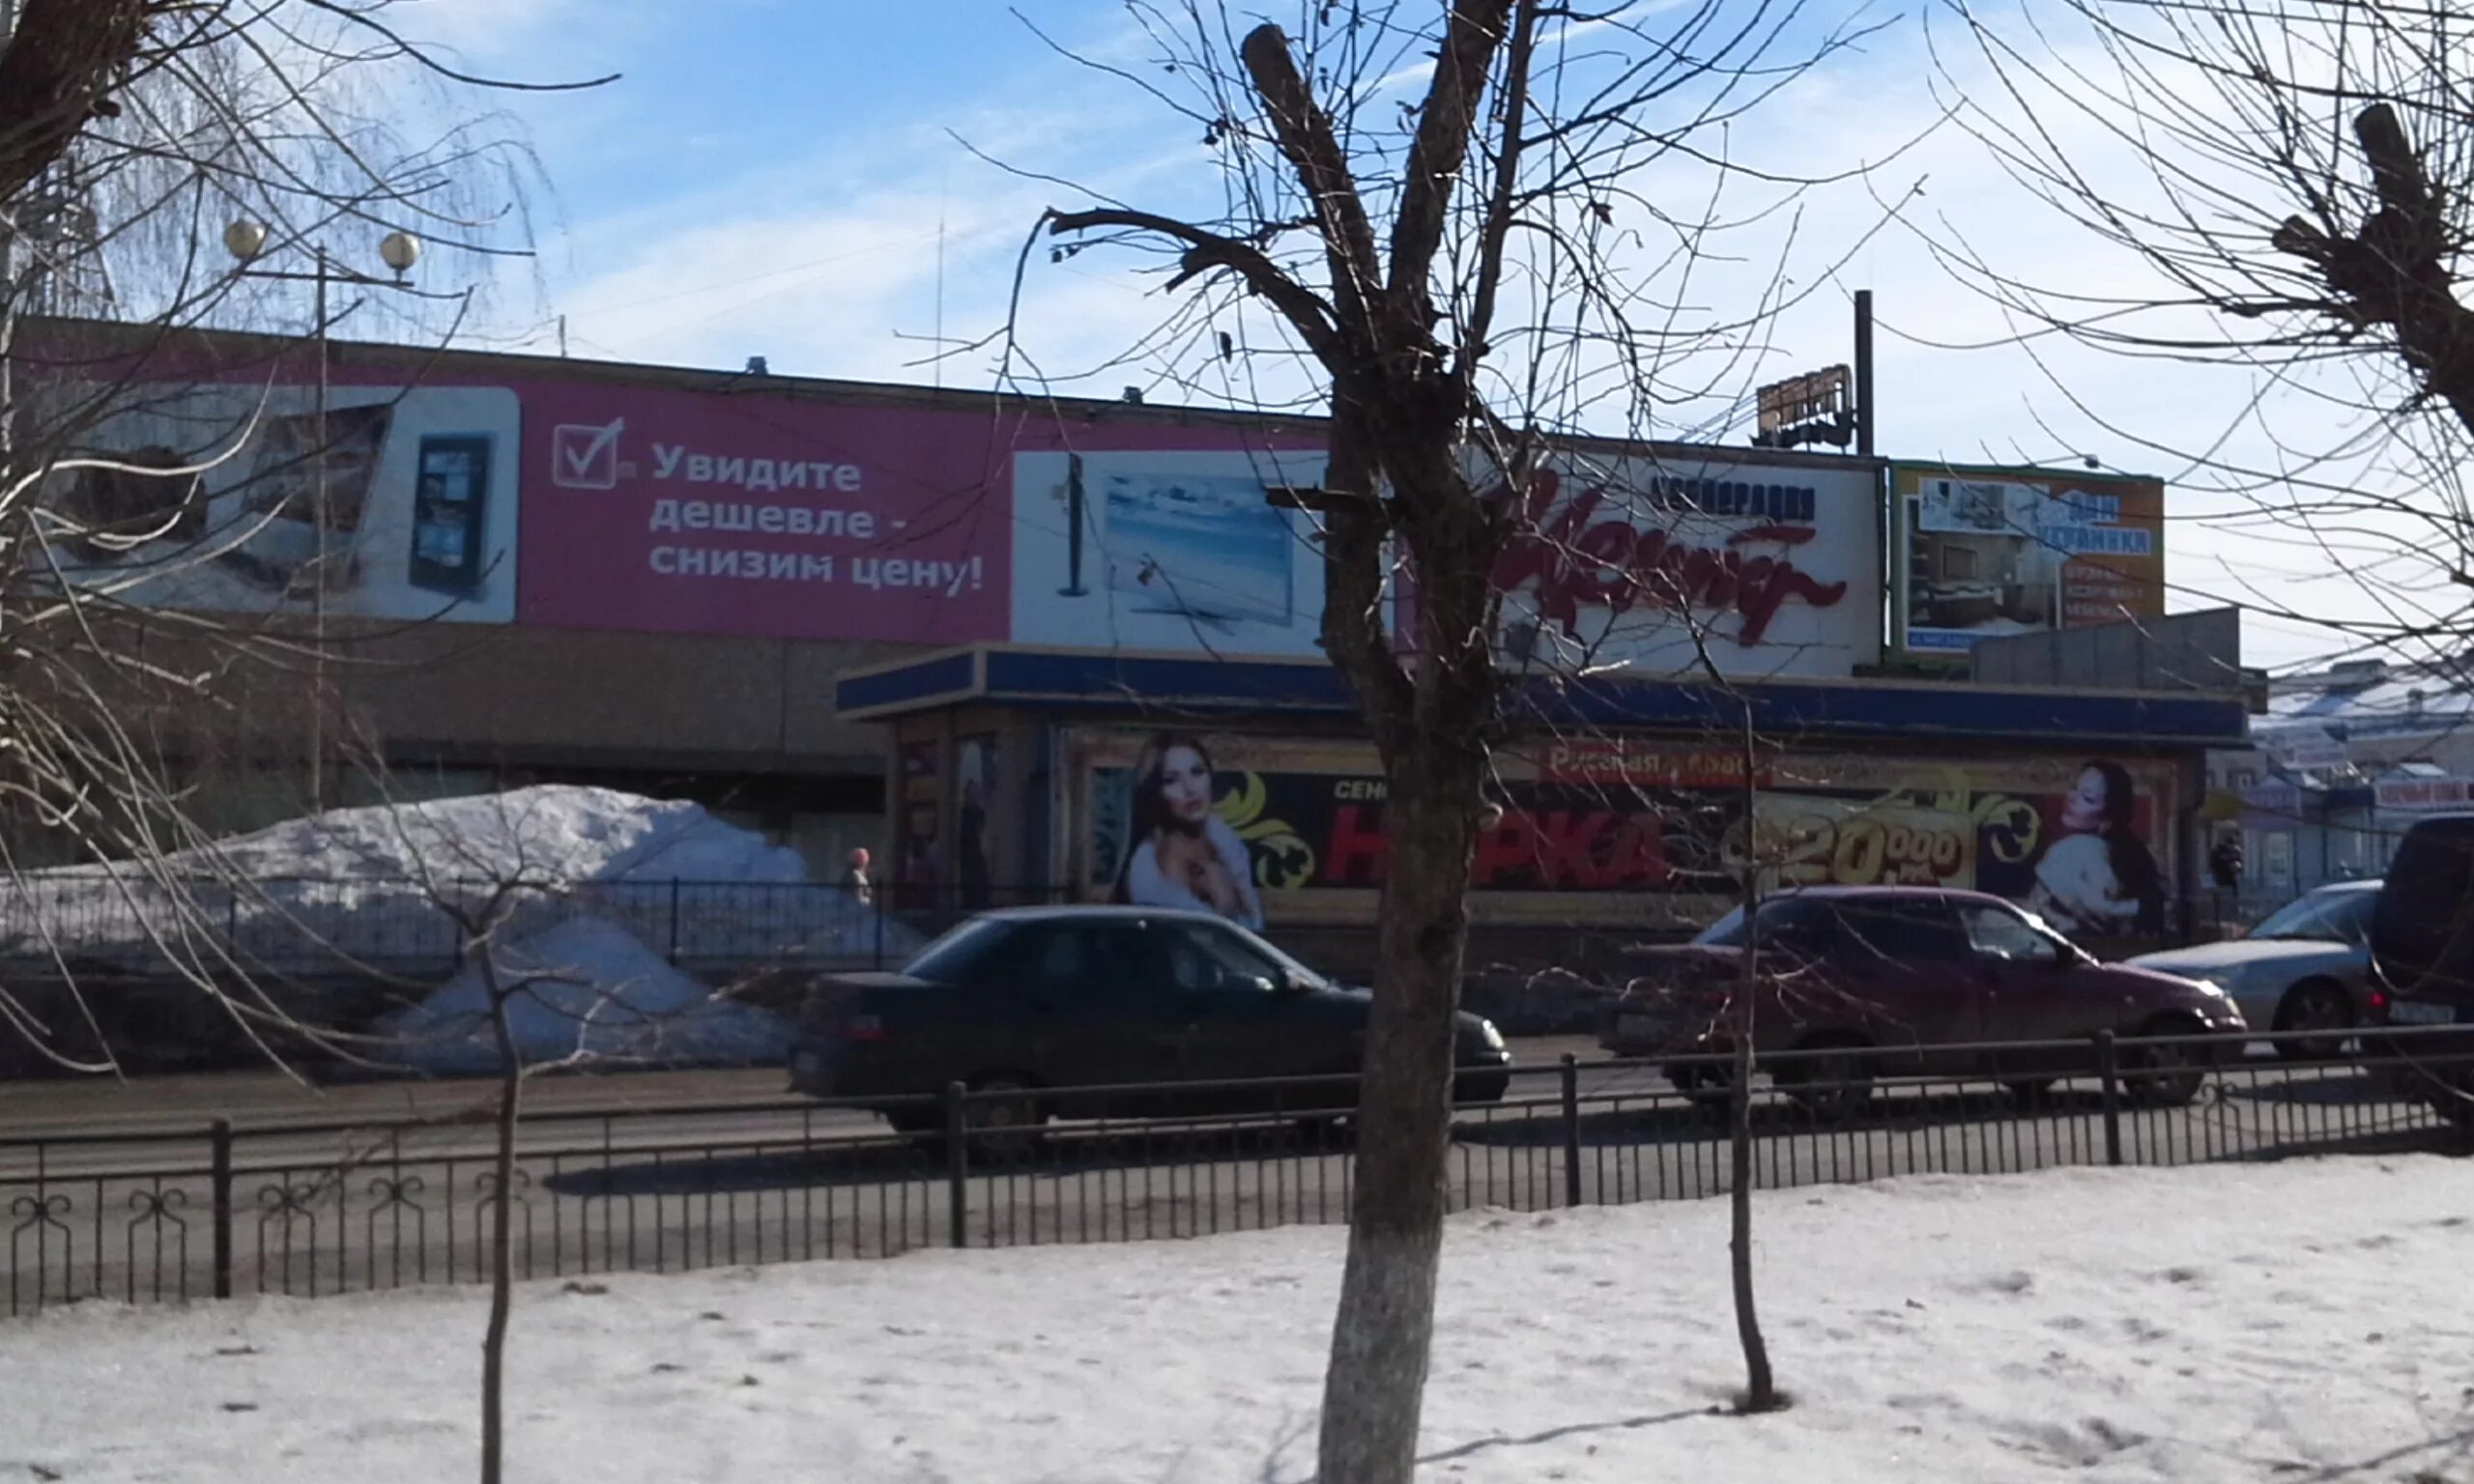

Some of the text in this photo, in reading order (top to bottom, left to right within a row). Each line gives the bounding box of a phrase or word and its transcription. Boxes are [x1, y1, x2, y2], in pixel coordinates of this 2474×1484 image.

[651, 443, 860, 494] Увидите
[649, 499, 874, 539] дешевле
[649, 545, 983, 597] снизим цену!
